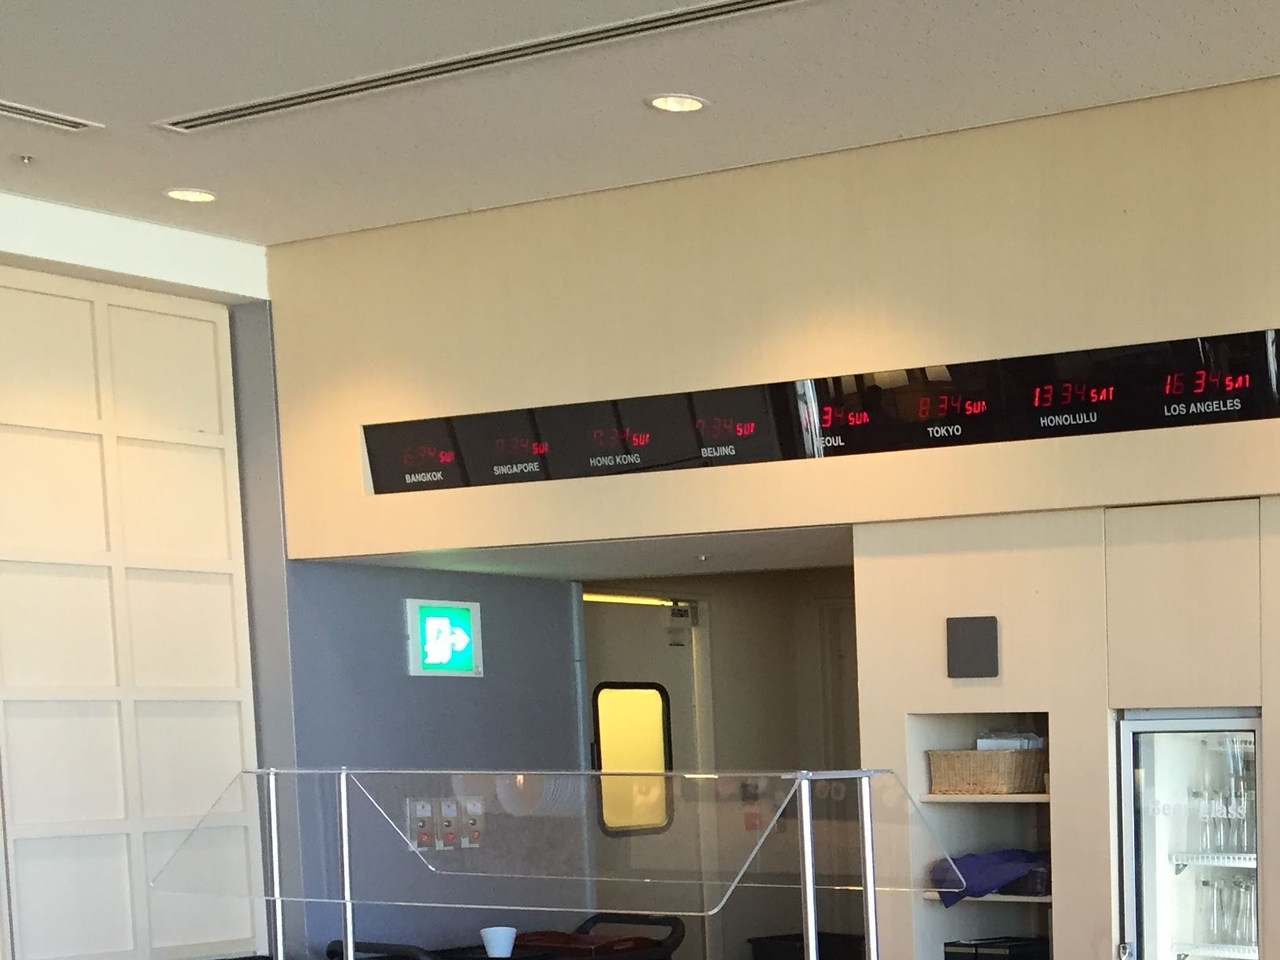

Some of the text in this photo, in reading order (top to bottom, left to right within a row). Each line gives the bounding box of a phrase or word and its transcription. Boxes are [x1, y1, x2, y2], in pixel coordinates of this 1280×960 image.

[1090, 386, 1114, 403] SAT
[1164, 398, 1242, 416] LOS ANGELES
[1040, 412, 1097, 428] HONOLULU
[927, 425, 962, 438] TOKYO
[814, 436, 845, 448] EOUL
[701, 445, 736, 457] BEIJING
[590, 453, 641, 467] HONG KONG
[493, 462, 540, 475] SINGAPORE
[405, 471, 444, 484] BANGKOK
[1199, 799, 1246, 822] glass
